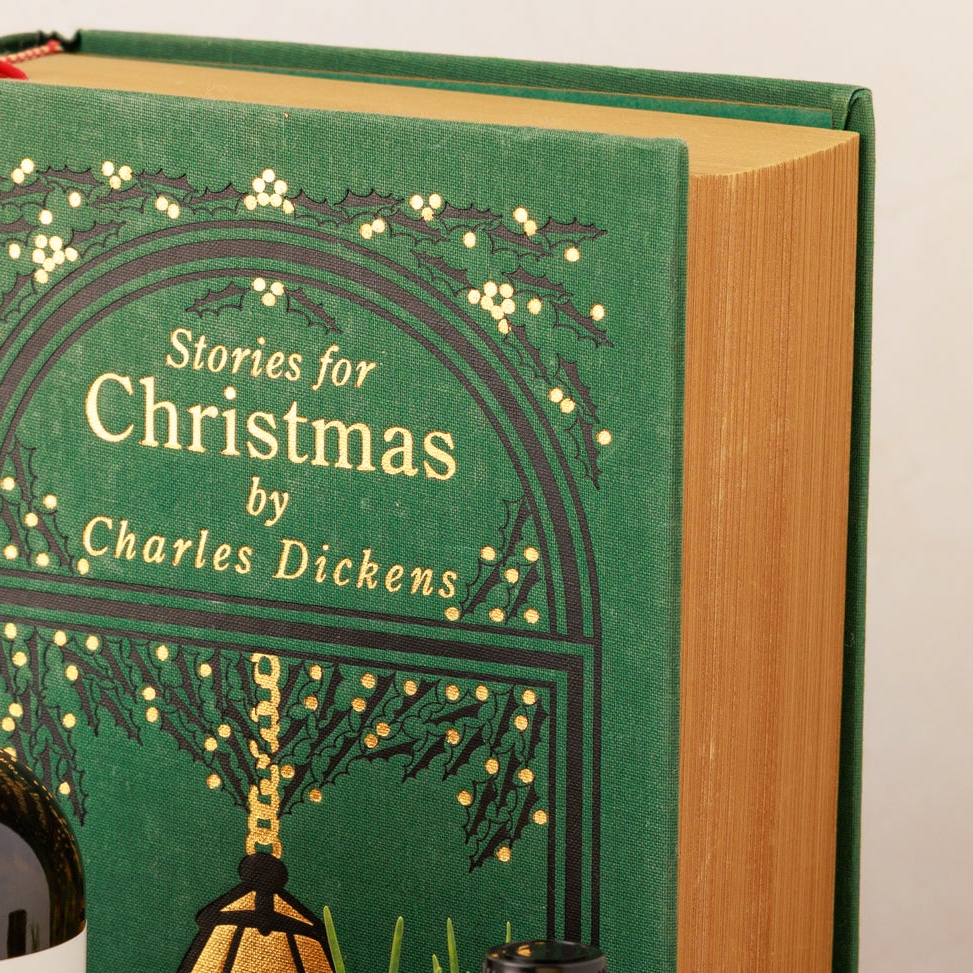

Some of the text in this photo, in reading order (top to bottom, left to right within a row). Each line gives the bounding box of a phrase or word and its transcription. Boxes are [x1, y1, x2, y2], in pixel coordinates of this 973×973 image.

[165, 328, 377, 391] Stories for
[85, 372, 458, 481] Christmas
[245, 477, 290, 526] by
[82, 516, 458, 599] Charles Dickens
